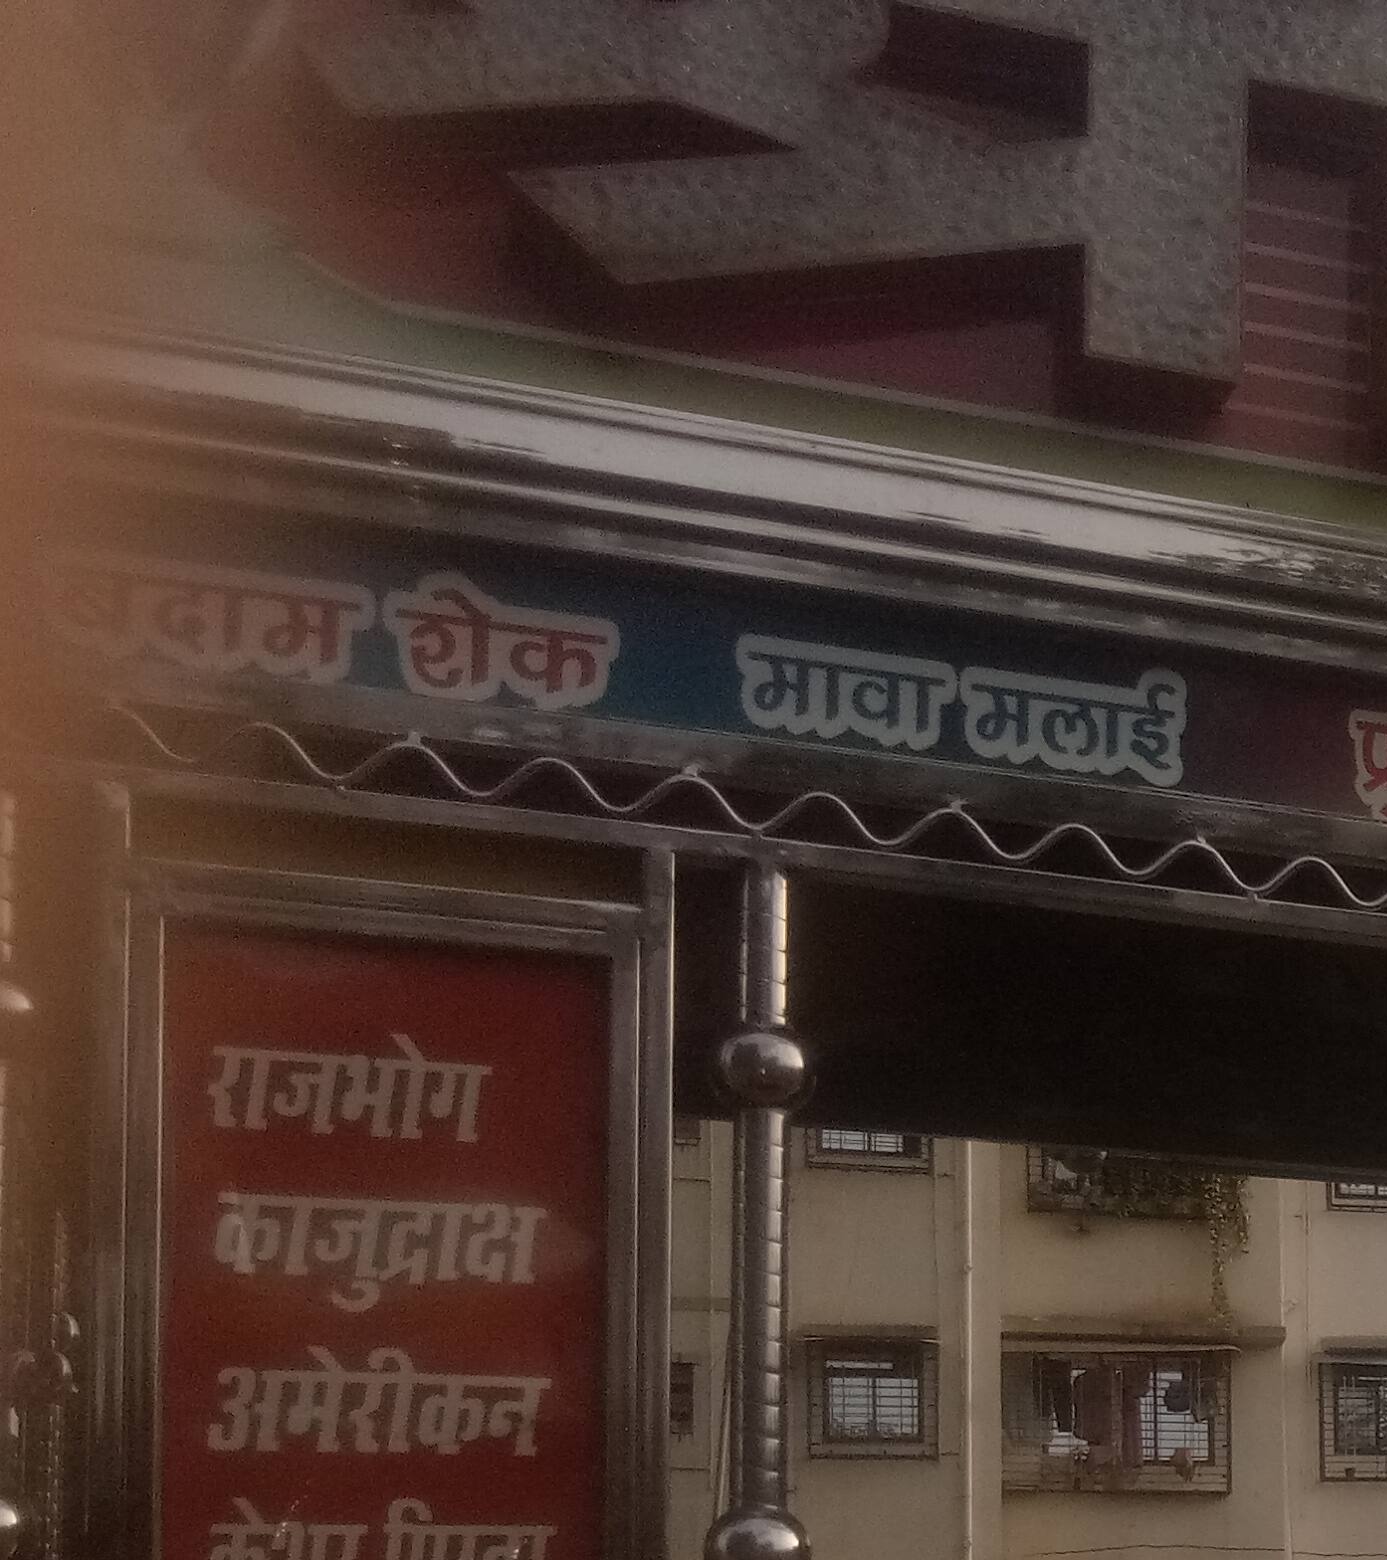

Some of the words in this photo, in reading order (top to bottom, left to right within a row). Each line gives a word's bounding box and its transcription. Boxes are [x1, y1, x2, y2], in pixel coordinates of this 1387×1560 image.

[390, 580, 612, 697] शेक
[741, 642, 952, 742] मावा
[966, 675, 1180, 780] मलाई
[209, 1033, 492, 1143] राजभोग
[207, 1345, 552, 1456] अमेरीकन
